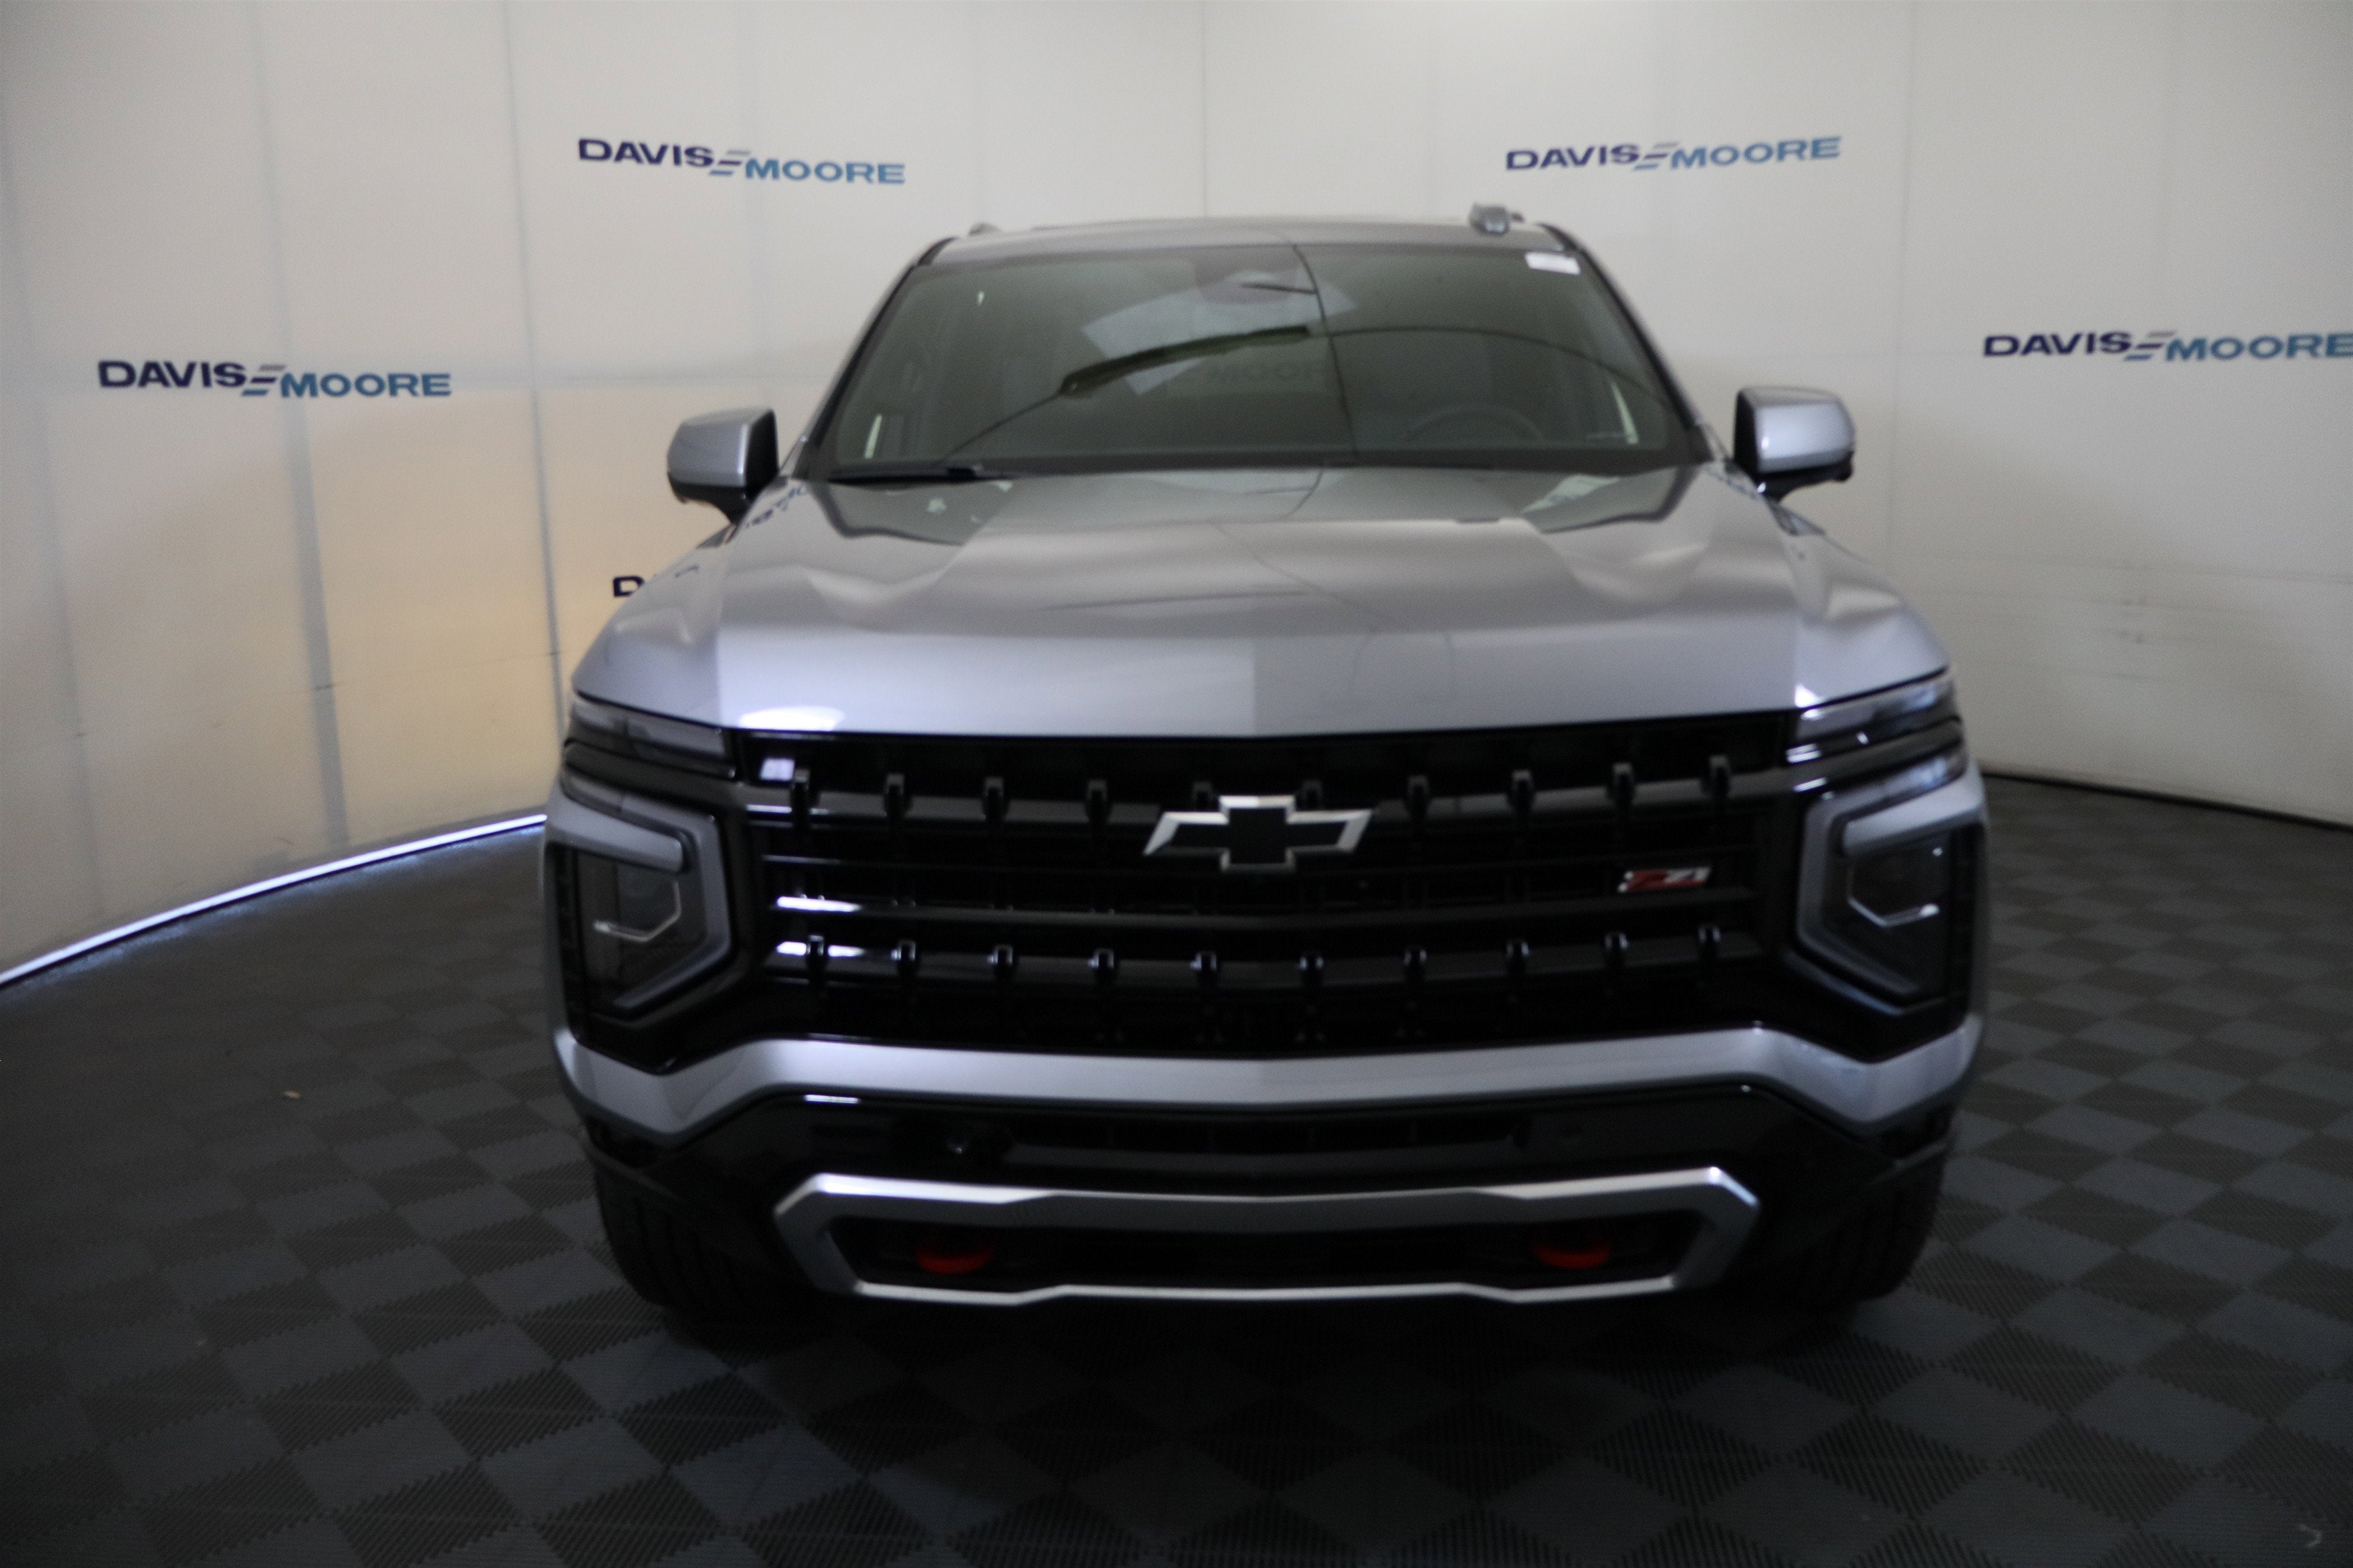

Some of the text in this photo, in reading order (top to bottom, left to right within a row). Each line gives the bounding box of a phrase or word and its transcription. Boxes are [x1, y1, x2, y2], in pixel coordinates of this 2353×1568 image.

[578, 138, 905, 184] DAVIS MOORE
[1505, 136, 1841, 171] DAVIS MOORE
[1983, 331, 2353, 361] DAVIS MOORE
[98, 361, 452, 397] DAVIS MOORE
